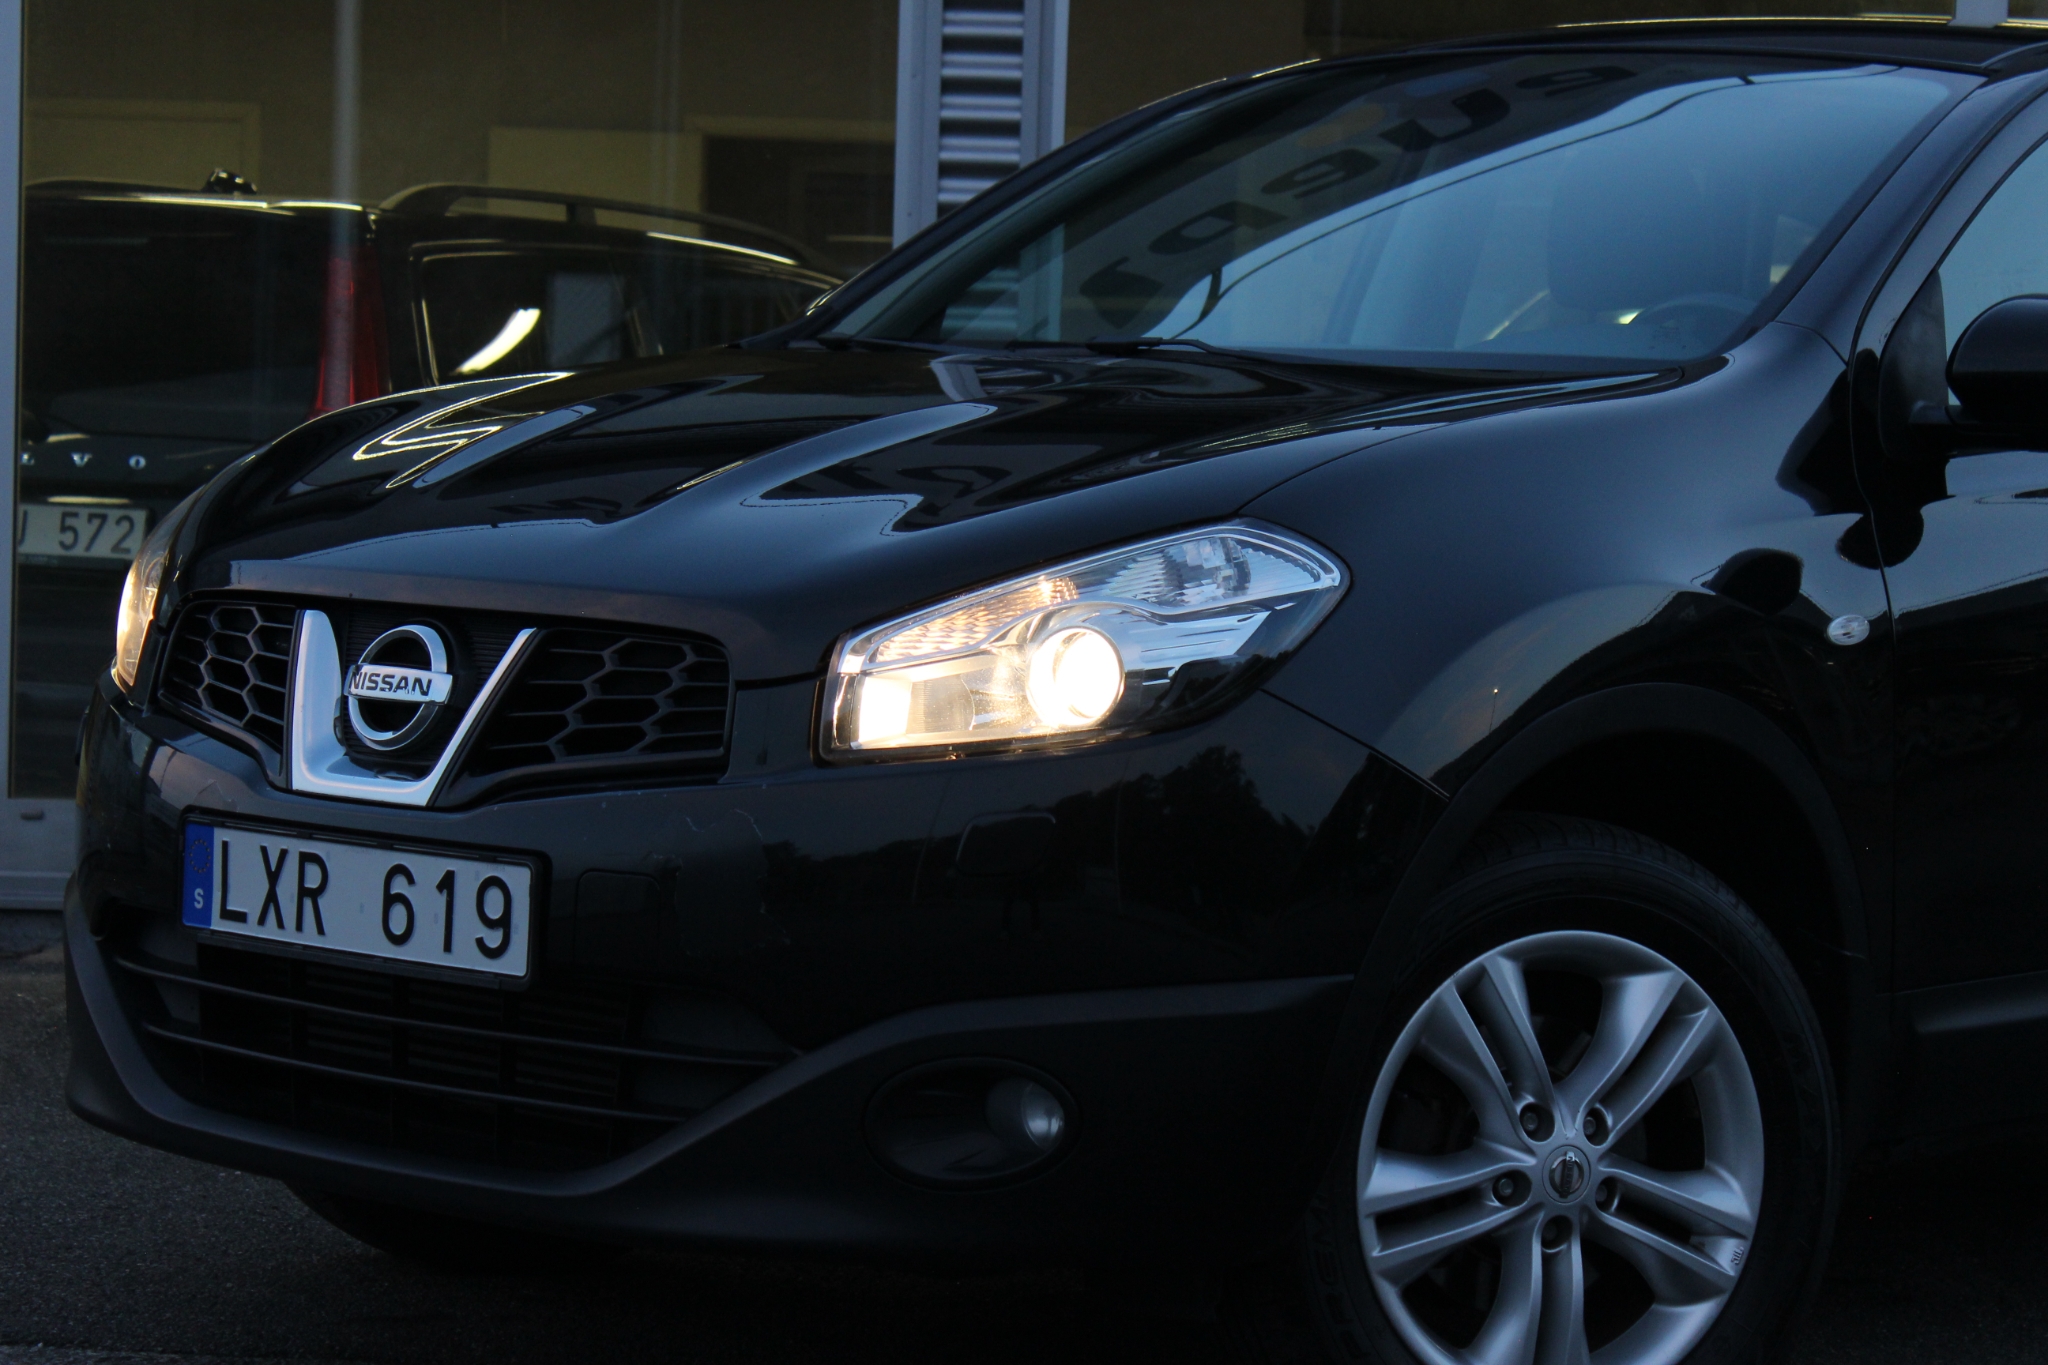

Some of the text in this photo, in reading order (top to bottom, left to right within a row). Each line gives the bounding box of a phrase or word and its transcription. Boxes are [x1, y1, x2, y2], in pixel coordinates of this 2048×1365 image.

[58, 511, 135, 555] 572
[348, 667, 433, 697] NISSAN
[193, 887, 205, 910] S
[219, 840, 513, 960] LXR 619
